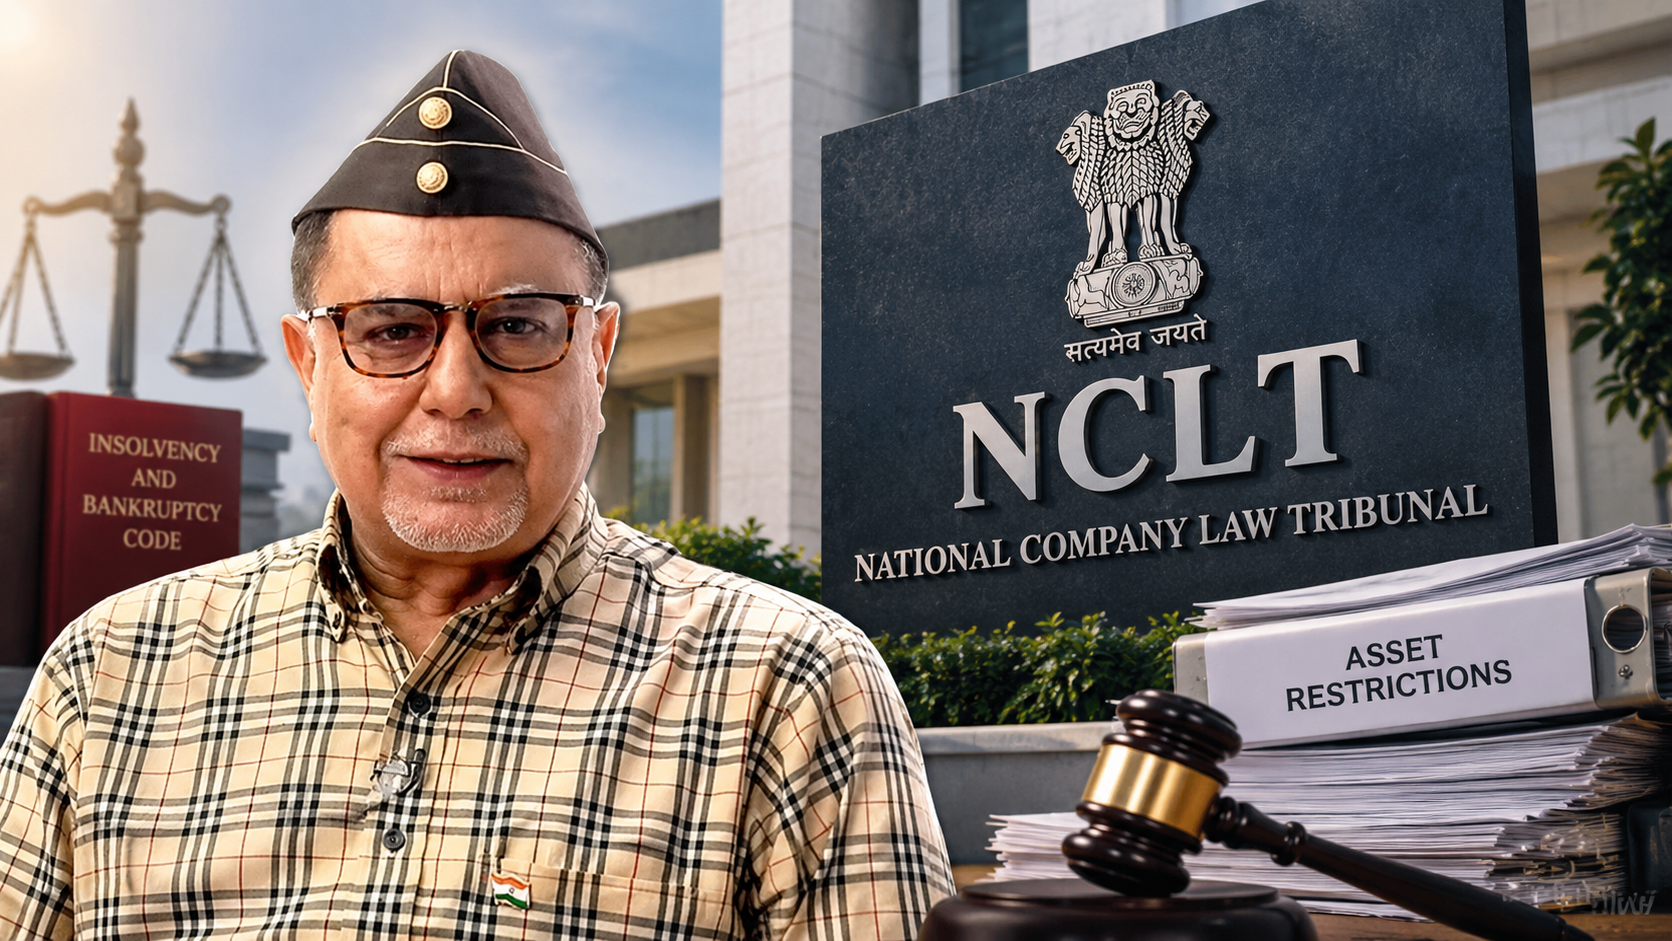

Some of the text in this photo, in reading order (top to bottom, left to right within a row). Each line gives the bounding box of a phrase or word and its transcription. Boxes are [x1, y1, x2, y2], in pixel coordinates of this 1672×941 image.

[1064, 313, 1207, 362] सत्यमेव जयते
[953, 340, 1361, 509] NCLT
[88, 432, 221, 463] INSOLVENCY
[131, 468, 176, 489] AND
[82, 494, 222, 522] BANKRUPTCY
[123, 528, 182, 551] CODE
[854, 485, 1488, 582] NATIONAL COMPANY LAW TRIBUNAL
[1346, 635, 1443, 671] ASSET
[1286, 659, 1512, 712] RESTRICTIONS
